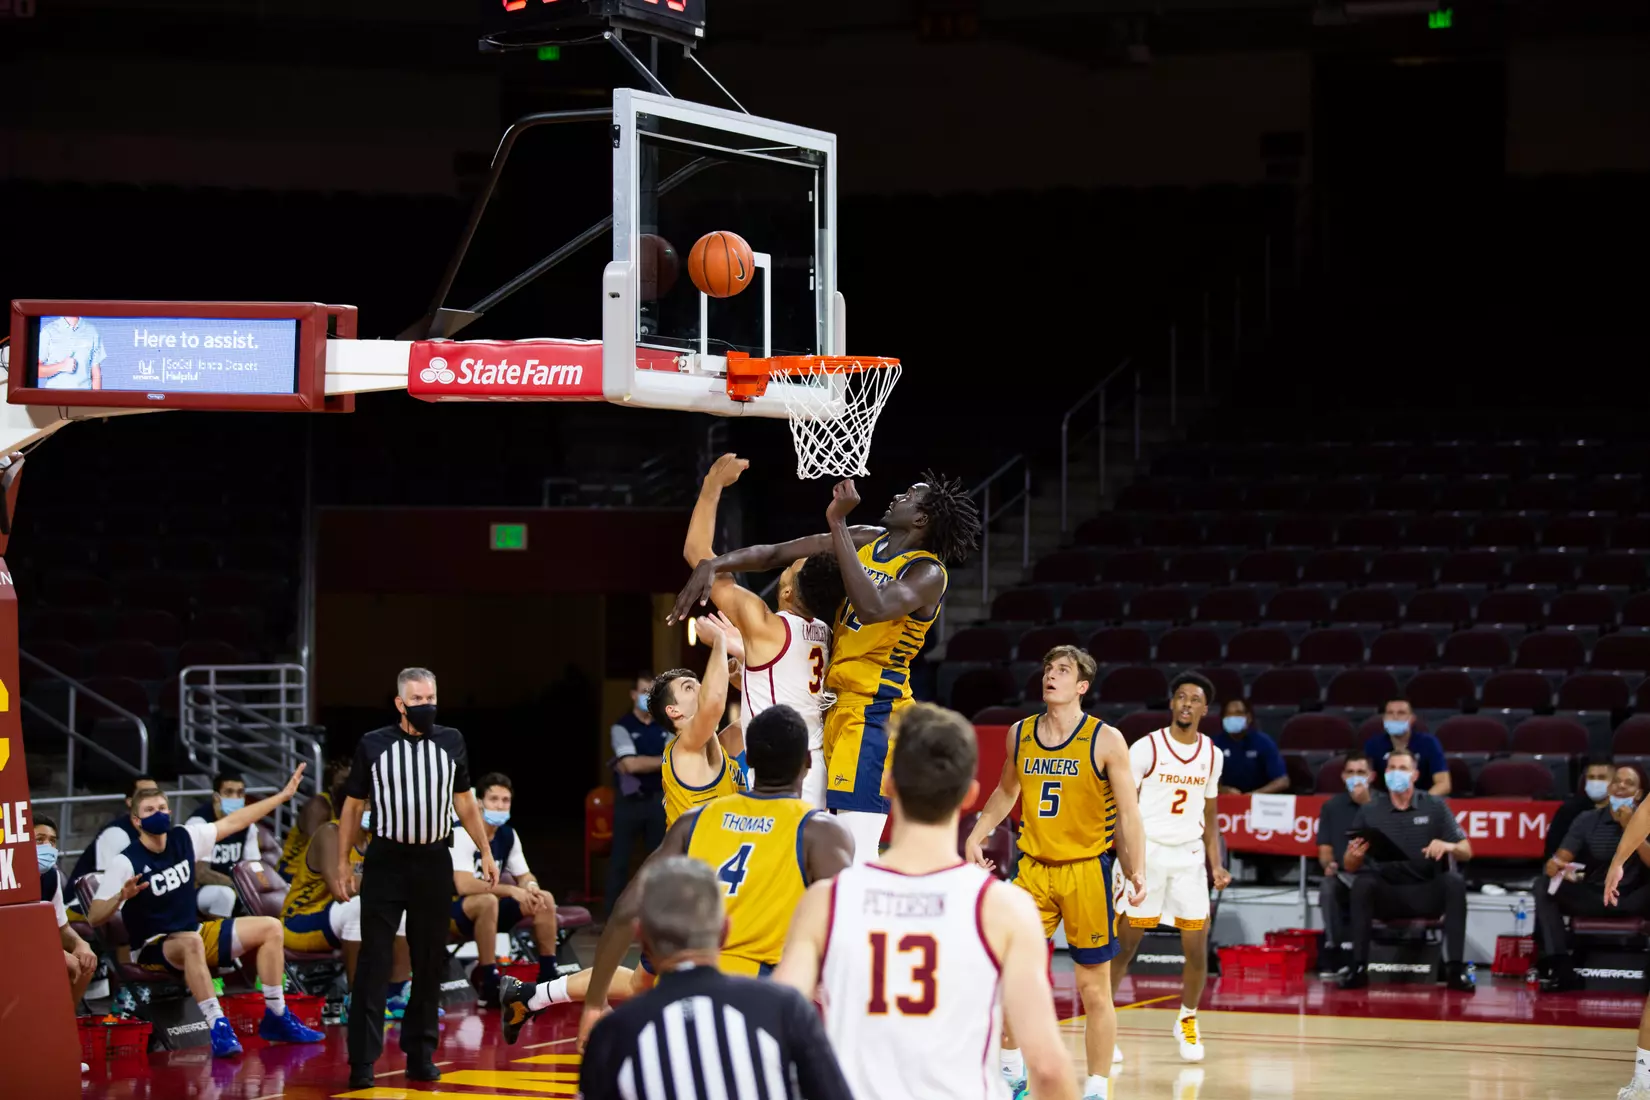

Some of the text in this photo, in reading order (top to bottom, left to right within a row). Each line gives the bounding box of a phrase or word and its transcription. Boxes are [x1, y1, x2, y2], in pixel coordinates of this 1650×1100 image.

[133, 328, 259, 349] Here to assist.
[808, 644, 824, 694] 3
[1024, 757, 1080, 776] LANCERS
[1158, 773, 1206, 786] TROJANS
[1038, 781, 1062, 818] 5
[1170, 789, 1188, 814] 2
[720, 812, 775, 834] THOMAS
[1518, 812, 1551, 840] M
[150, 859, 191, 897] CBU
[717, 842, 756, 897] 4
[866, 931, 938, 1017] 13
[166, 1020, 210, 1037] POWERADE
